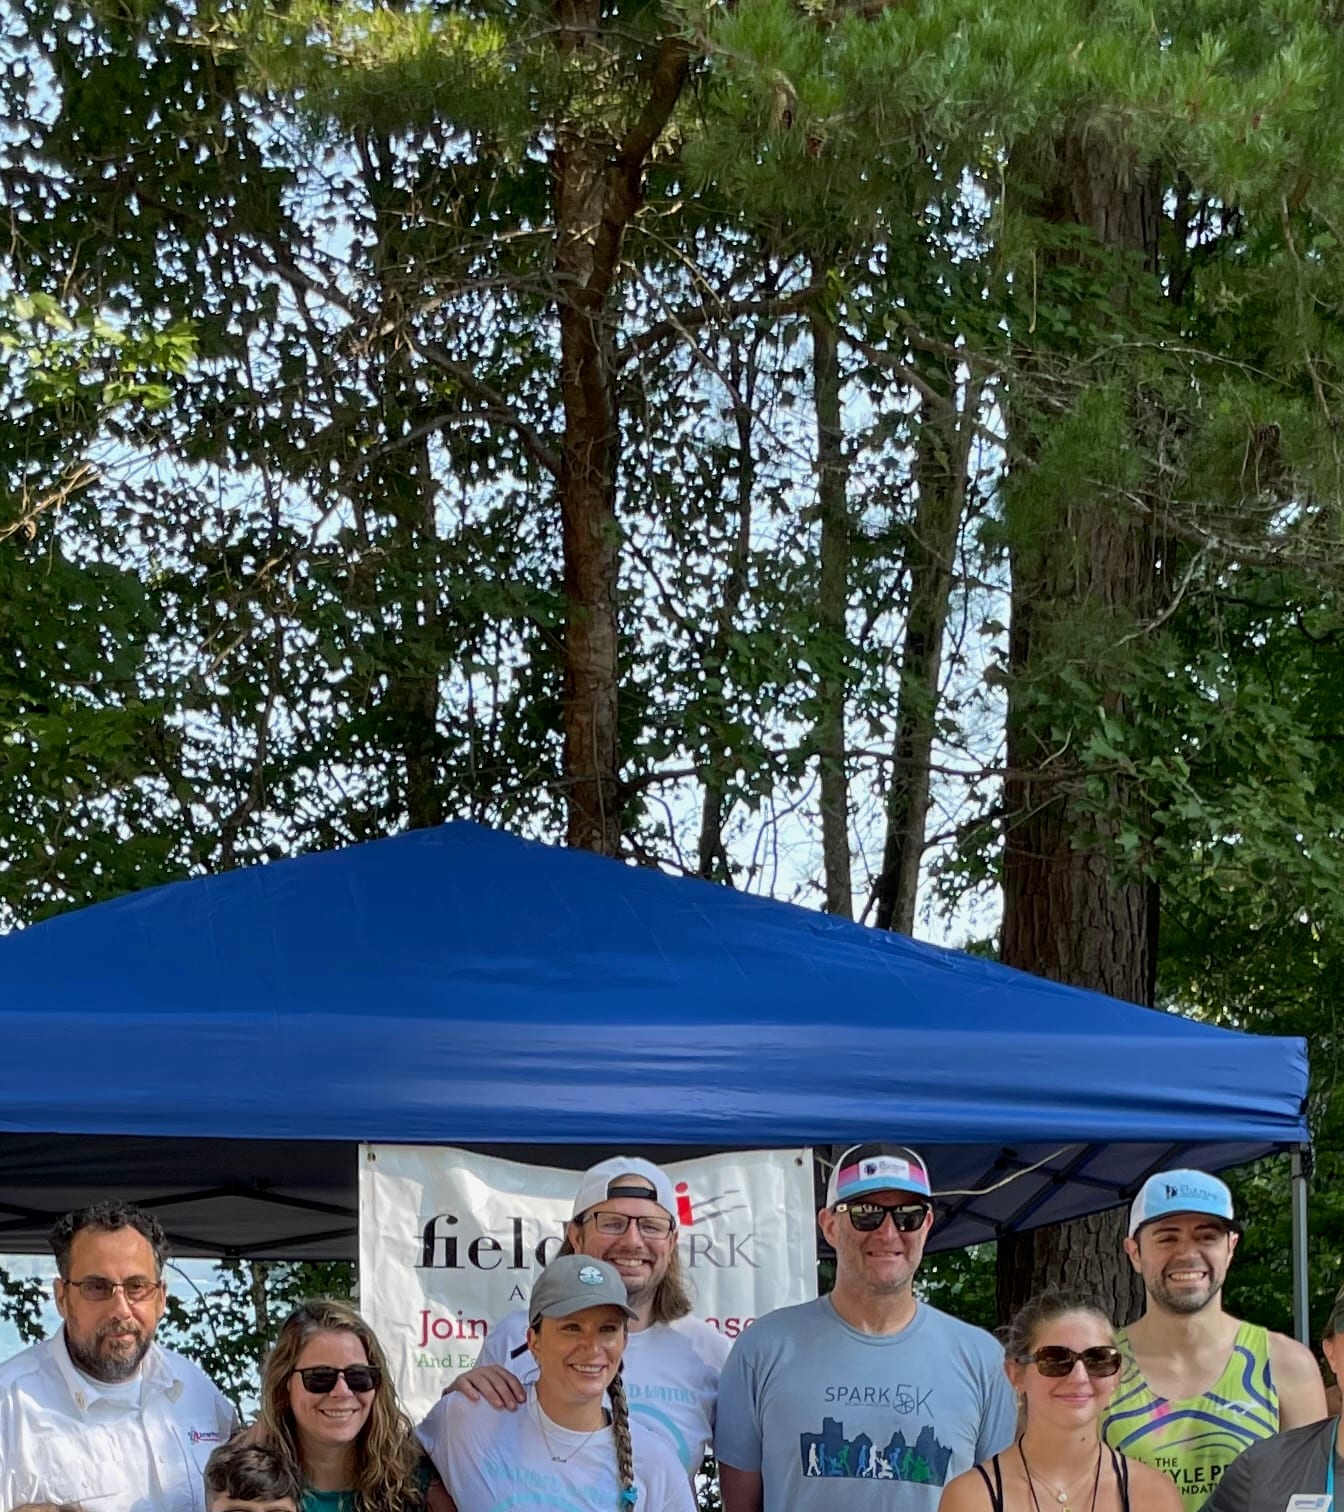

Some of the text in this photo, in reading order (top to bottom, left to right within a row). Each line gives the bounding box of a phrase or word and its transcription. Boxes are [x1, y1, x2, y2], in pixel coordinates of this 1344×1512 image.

[418, 1310, 488, 1347] Join
[418, 1354, 453, 1368] And
[824, 1383, 934, 1418] SPARK 5K
[1156, 1457, 1178, 1468] THE
[1163, 1466, 1206, 1484] YLE
